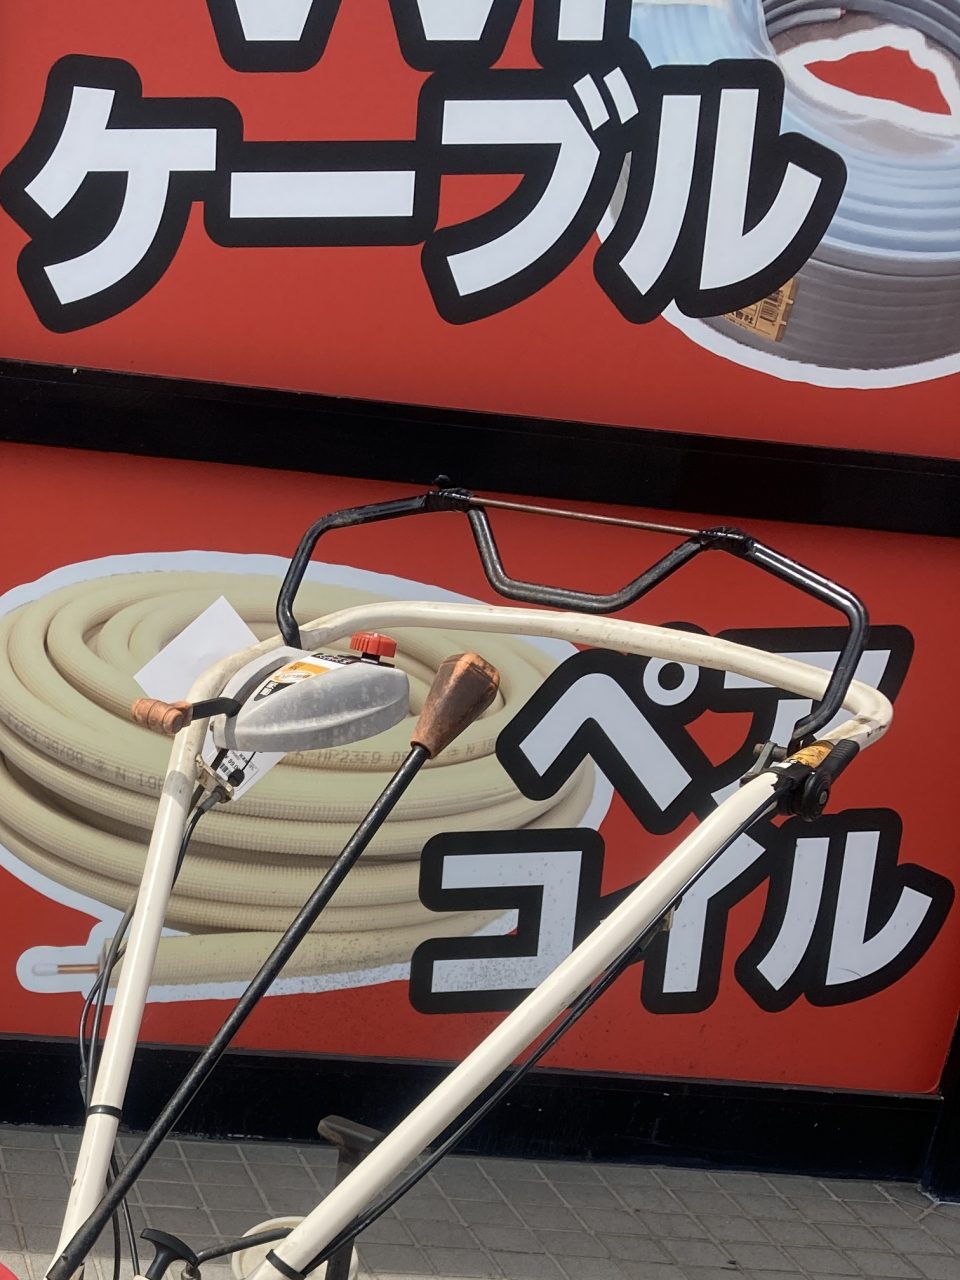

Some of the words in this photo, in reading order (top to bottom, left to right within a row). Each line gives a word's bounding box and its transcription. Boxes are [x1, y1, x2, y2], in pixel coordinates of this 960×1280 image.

[23, 66, 823, 306] ケーブル
[430, 830, 934, 994] コイル
